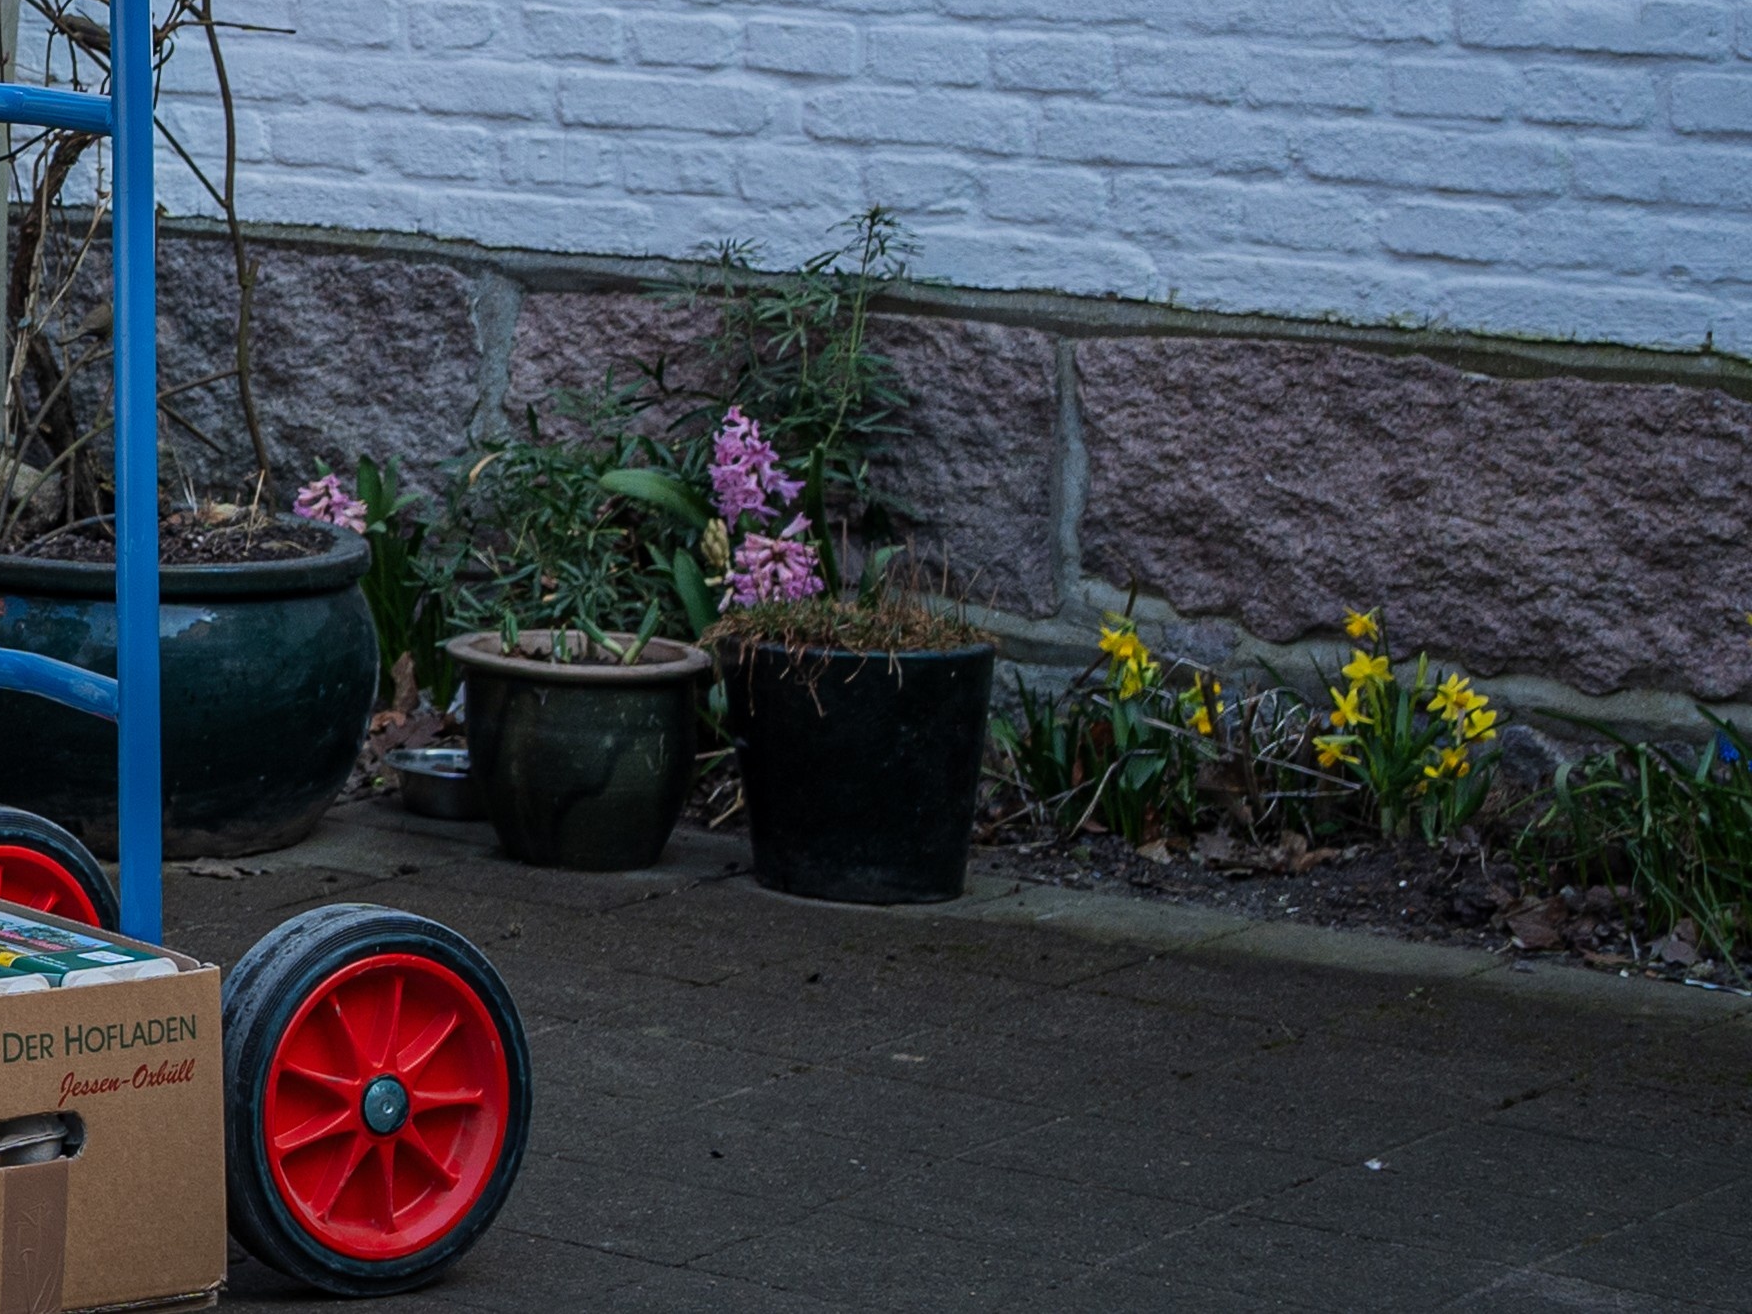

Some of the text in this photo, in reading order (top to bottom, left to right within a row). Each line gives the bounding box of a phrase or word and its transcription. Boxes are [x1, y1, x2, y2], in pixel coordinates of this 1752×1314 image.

[2, 1014, 197, 1064] DER HOFLADEN
[58, 1058, 195, 1108] Jessen-Oxbüll
